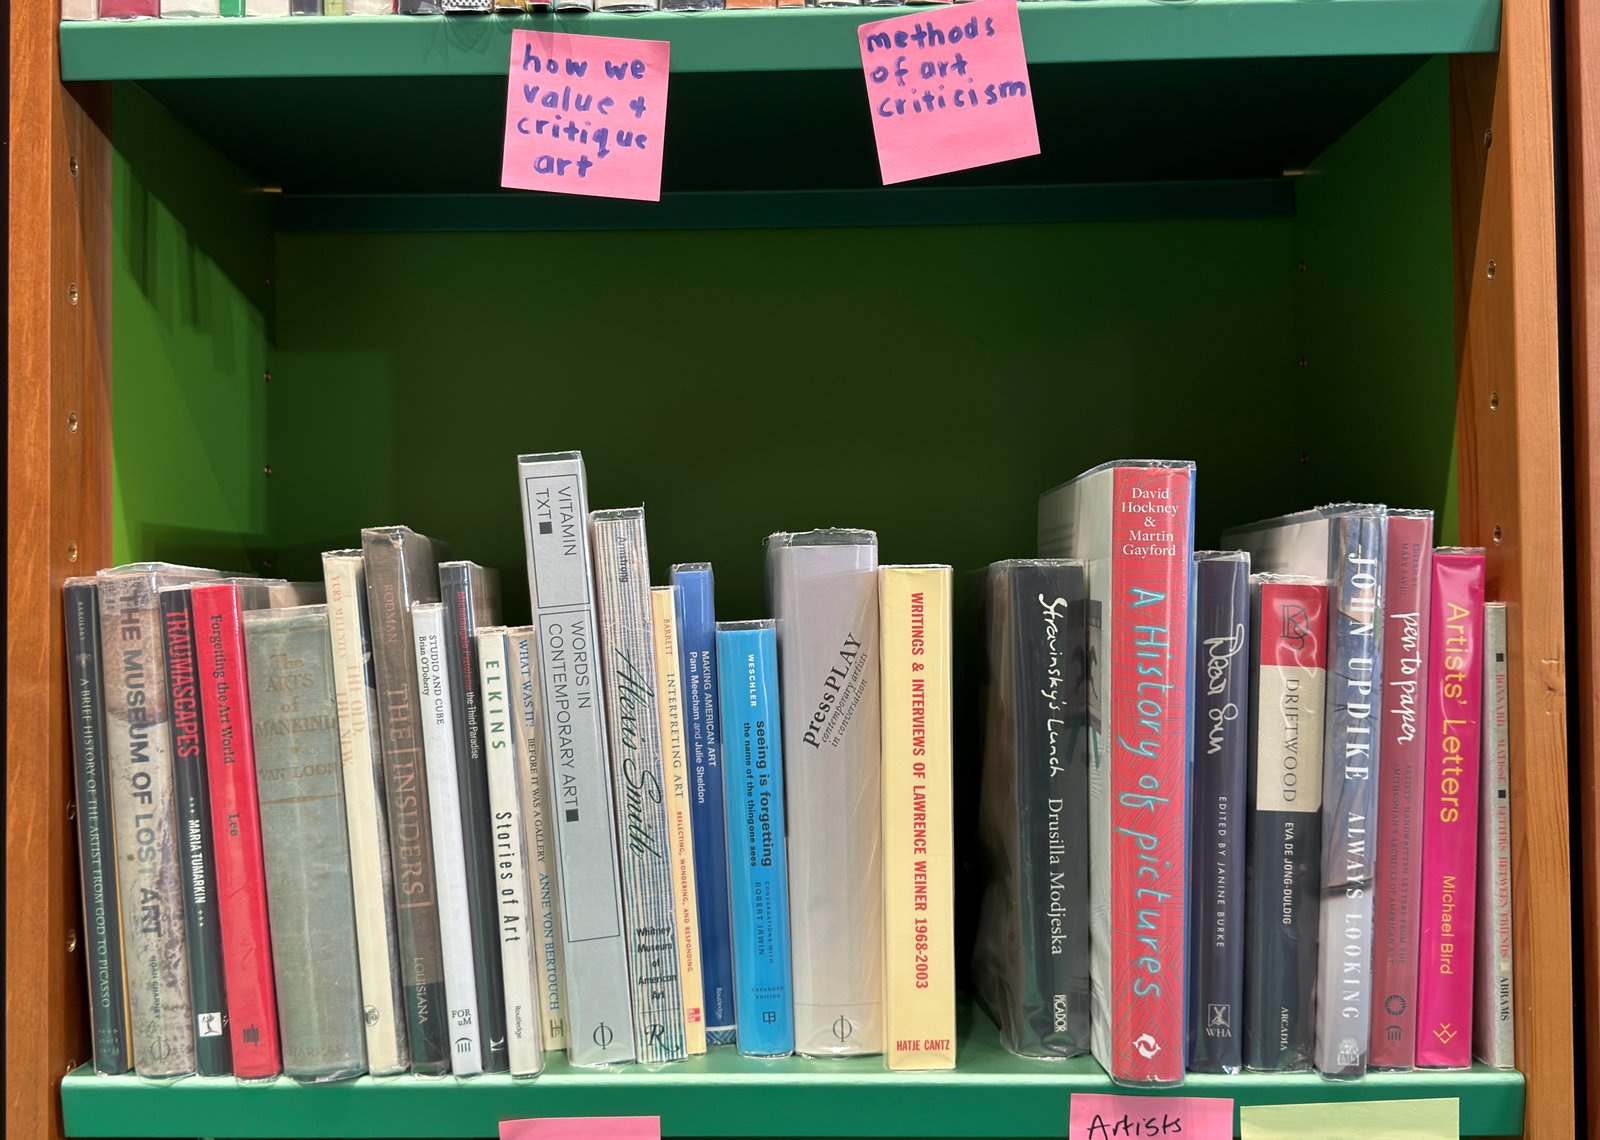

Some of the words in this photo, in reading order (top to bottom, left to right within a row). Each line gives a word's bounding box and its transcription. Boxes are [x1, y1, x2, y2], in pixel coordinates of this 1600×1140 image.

[867, 17, 996, 53] methods
[523, 44, 588, 79] how
[604, 58, 646, 80] we
[871, 55, 909, 85] of
[920, 53, 969, 79] art
[523, 83, 614, 116] value
[877, 78, 1029, 118] criticism
[517, 116, 648, 158] critique
[534, 154, 594, 178] art
[536, 488, 552, 519] TXT
[1122, 502, 1178, 517] Hockney
[1132, 488, 1169, 499] David
[558, 486, 577, 556] VITAMIN
[1129, 530, 1174, 542] Martin
[1144, 516, 1156, 527] &
[616, 536, 629, 583] Armstrong
[1123, 544, 1176, 559] Gayford
[383, 584, 398, 643] RODMAN
[1128, 586, 1168, 608] A
[1348, 553, 1377, 637] JOHN
[119, 589, 142, 642] THE
[911, 592, 925, 656] WRITINGS
[1390, 613, 1420, 652] pen
[210, 614, 226, 679] Forgetting
[418, 636, 427, 657] Brian
[429, 635, 440, 672] STUDIO
[571, 621, 589, 686] WORDS
[663, 618, 673, 655] BARRETT
[1038, 593, 1068, 712] Stravinsky's
[270, 655, 304, 669] The
[519, 639, 531, 675] WHAT
[689, 651, 698, 673] Pam
[702, 651, 712, 690] MAKING
[911, 662, 925, 672] &
[1400, 651, 1423, 675] to
[166, 608, 200, 758] TRAUMASCAPES
[217, 682, 229, 703] the
[266, 673, 313, 692] ARTS
[420, 658, 430, 696] O'Doherty
[433, 674, 442, 696] AND
[522, 679, 535, 708] WAS
[748, 654, 757, 707] WESCHLER
[803, 692, 835, 750] press
[824, 632, 862, 692] PLAY
[1117, 625, 1175, 759] History
[123, 650, 151, 763] MUSEUM
[217, 705, 231, 725] Art
[281, 696, 299, 713] of
[387, 683, 412, 742] THE
[435, 696, 445, 725] CUBE
[468, 705, 476, 726] Third
[486, 660, 506, 750] ELKINS
[548, 623, 575, 769] CONTEMPORARY
[563, 774, 578, 807] ART
[577, 691, 591, 709] IN
[615, 648, 654, 751] Alexis
[691, 675, 700, 720] Meecham
[822, 682, 857, 743] contemporary
[852, 652, 868, 683] artists
[837, 678, 867, 735] conversation
[1390, 681, 1418, 745] paper
[255, 715, 337, 737] MANKIND
[666, 673, 681, 769] INTERPRETING
[704, 692, 715, 745] AMERICAN
[911, 679, 925, 756] INTERVIEWS
[1345, 658, 1373, 780] UPDIKE
[83, 725, 96, 775] HISTORY
[220, 726, 237, 765] World
[470, 726, 481, 760] Paradise
[528, 738, 538, 774] BEFORE
[695, 741, 703, 763] Julie
[708, 747, 717, 767] ART
[756, 720, 769, 769] seeing
[1047, 718, 1065, 777] Lunch
[1283, 679, 1300, 803] DRIFTWOOD
[132, 771, 153, 805] OF
[293, 763, 337, 779] LOON
[674, 776, 684, 798] ART
[696, 766, 706, 804] Sheldon
[759, 774, 770, 787] is
[912, 762, 926, 779] OF
[1440, 719, 1467, 823] Letters
[88, 799, 98, 823] THE
[532, 788, 541, 808] WAS
[623, 758, 662, 861] Smith
[1118, 775, 1170, 812] of
[188, 819, 202, 852] MARIA
[228, 813, 240, 837] Lee
[393, 761, 425, 896] INSIDERS
[758, 790, 774, 868] forgetting
[913, 785, 927, 855] LAWRENCE
[1048, 798, 1065, 864] Drusilla
[1217, 796, 1227, 837] EDITED
[1283, 822, 1294, 840] EVA
[90, 825, 101, 866] ARTIST
[134, 814, 158, 875] LOST
[495, 811, 515, 879] Stories
[534, 819, 545, 863] GALLERY
[1217, 842, 1226, 856] BY
[1283, 843, 1294, 856] DE
[1346, 812, 1366, 899] ALWAYS
[93, 870, 104, 903] FROM
[191, 853, 206, 904] TUMARKIN
[502, 888, 519, 906] of
[539, 873, 551, 908] ANNE
[914, 860, 927, 912] WEINER
[1216, 862, 1225, 905] JANINE
[1281, 858, 1294, 924] JONG-DULDIG
[1499, 857, 1509, 908] BETWEEN
[139, 887, 162, 938] ART
[755, 881, 763, 921] ROBERT
[1047, 872, 1067, 955] Modjeska
[1115, 827, 1172, 998] pictures
[1441, 876, 1456, 937] Michael
[95, 907, 106, 935] GOD
[503, 915, 521, 942] Art
[543, 912, 554, 940] VON
[636, 926, 671, 938] Whitney
[1216, 912, 1225, 948] BURKE
[1499, 913, 1510, 958] FRIENDS
[98, 938, 107, 955] TO
[638, 942, 672, 953] Museum
[652, 958, 660, 967] of
[684, 927, 693, 972] RESPONDING
[915, 917, 928, 989] 1968-2003
[1440, 943, 1454, 975] Bird
[100, 959, 110, 1008] PICASSO
[544, 943, 560, 1011] BERTOUCH
[638, 974, 677, 985] American
[1341, 914, 1363, 1019] LOOKING
[153, 980, 161, 1019] CHARNEY
[415, 957, 429, 1025] LOUISIANA
[652, 990, 665, 1000] Art
[1500, 976, 1510, 1021] ABRAMS
[451, 1009, 471, 1019] FOR
[514, 1005, 523, 1039] Routledge
[1053, 994, 1067, 1033] PICADOR
[1279, 1007, 1290, 1051] ARCADIA
[896, 1040, 921, 1051] HATJE
[924, 1039, 950, 1050] CANTZ
[1206, 1028, 1232, 1038] WHA
[1087, 1114, 1183, 1140] Artists
